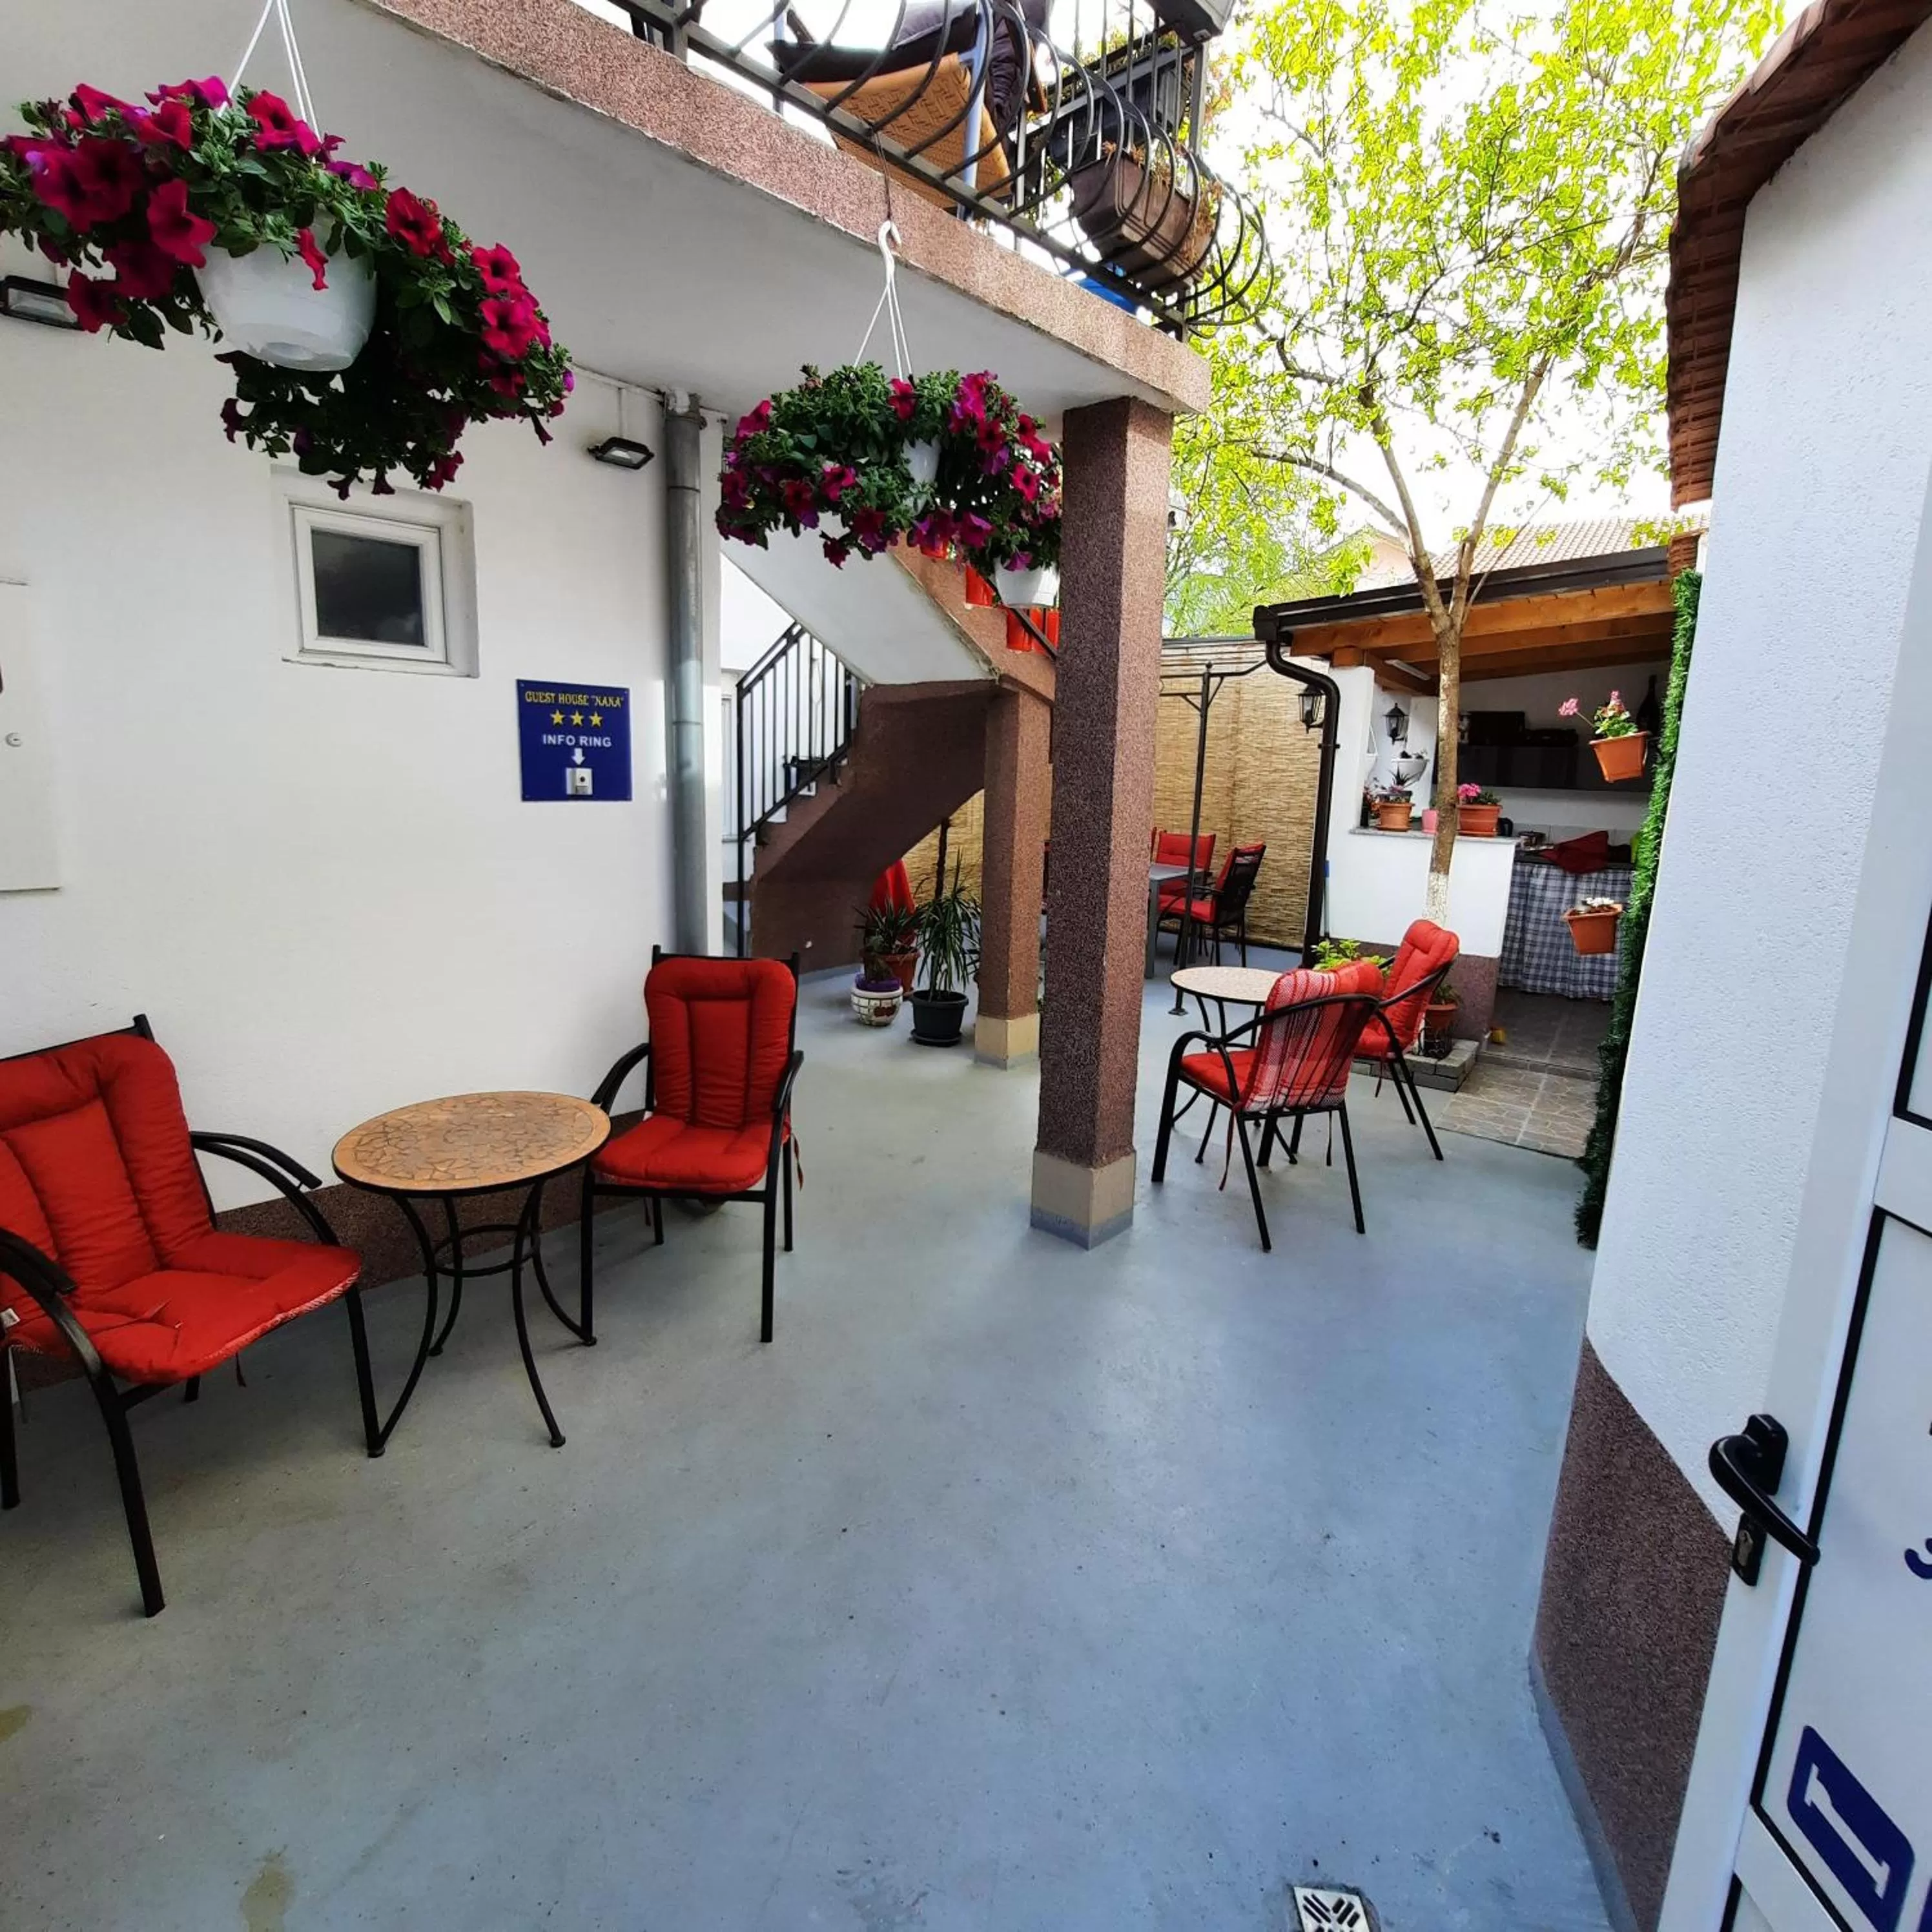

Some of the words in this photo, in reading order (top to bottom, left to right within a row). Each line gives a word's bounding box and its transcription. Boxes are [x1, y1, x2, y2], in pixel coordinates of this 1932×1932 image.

[525, 691, 555, 704] GUEST
[559, 693, 589, 706] HOUSE
[542, 734, 575, 746] INFO
[579, 735, 612, 747] RING
